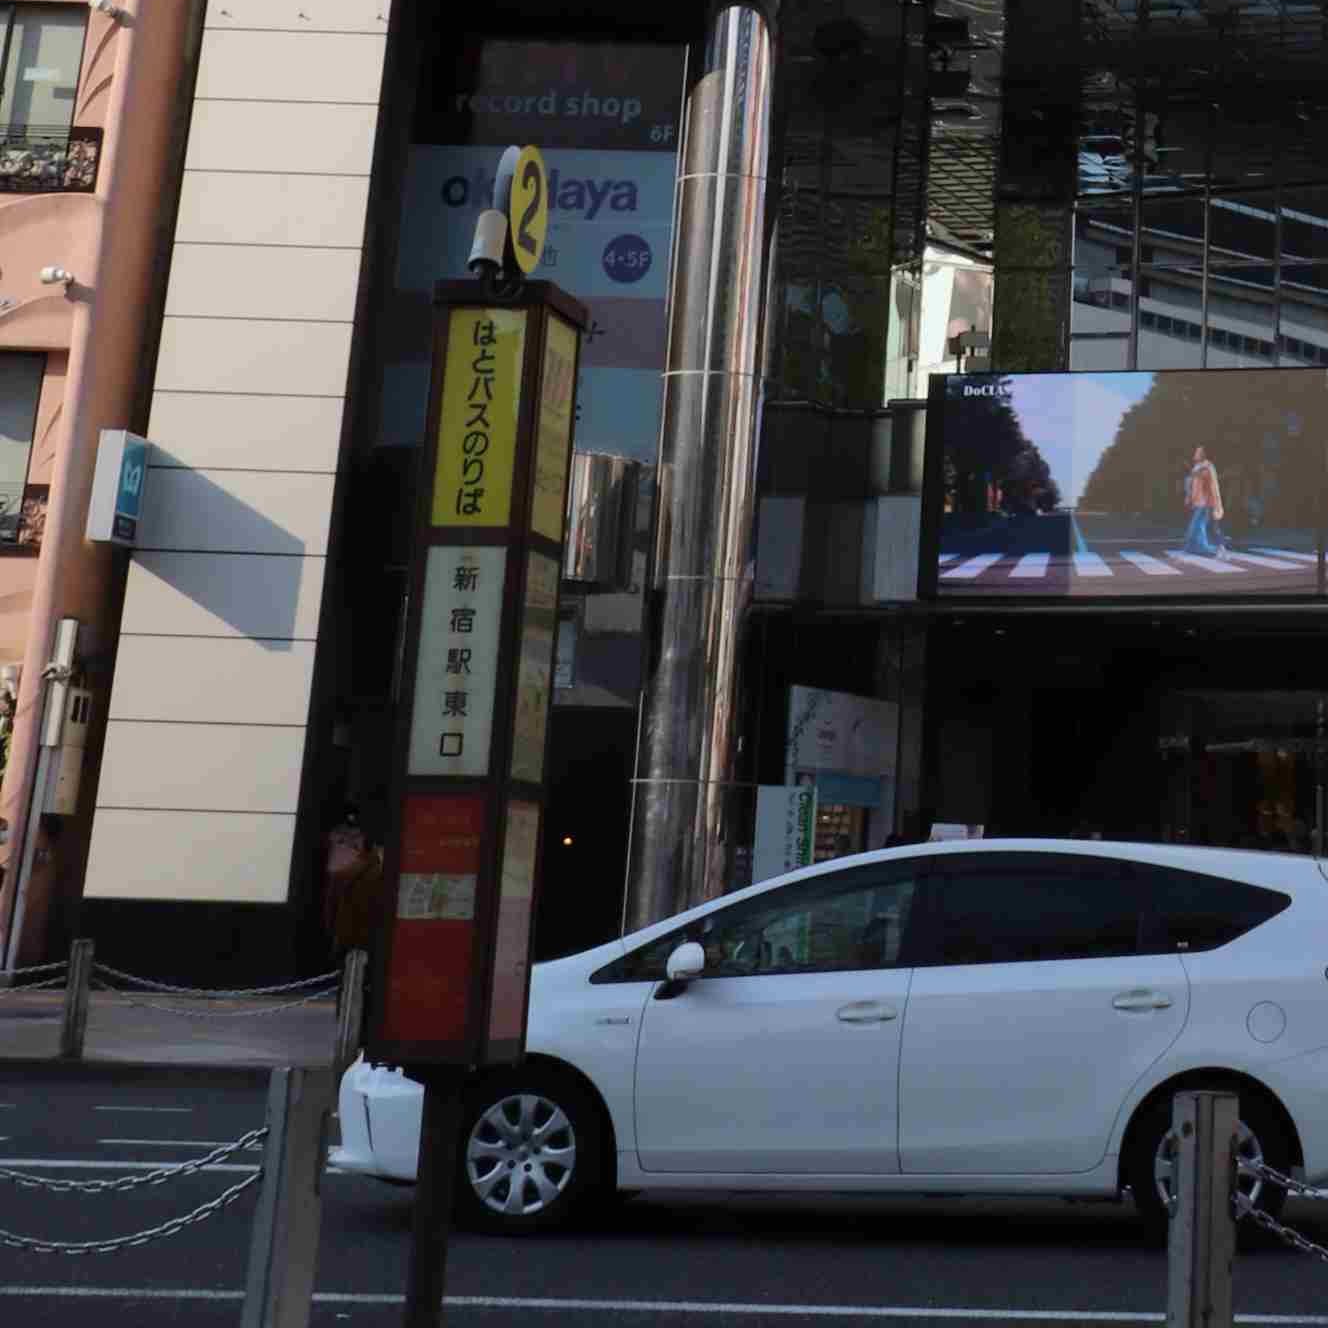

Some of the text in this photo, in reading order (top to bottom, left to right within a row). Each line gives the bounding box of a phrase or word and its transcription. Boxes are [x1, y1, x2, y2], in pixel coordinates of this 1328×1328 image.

[566, 93, 642, 124] shop
[518, 159, 541, 256] 2
[456, 319, 497, 516] はとバスのりば
[439, 566, 479, 757] 新宿駅東口
